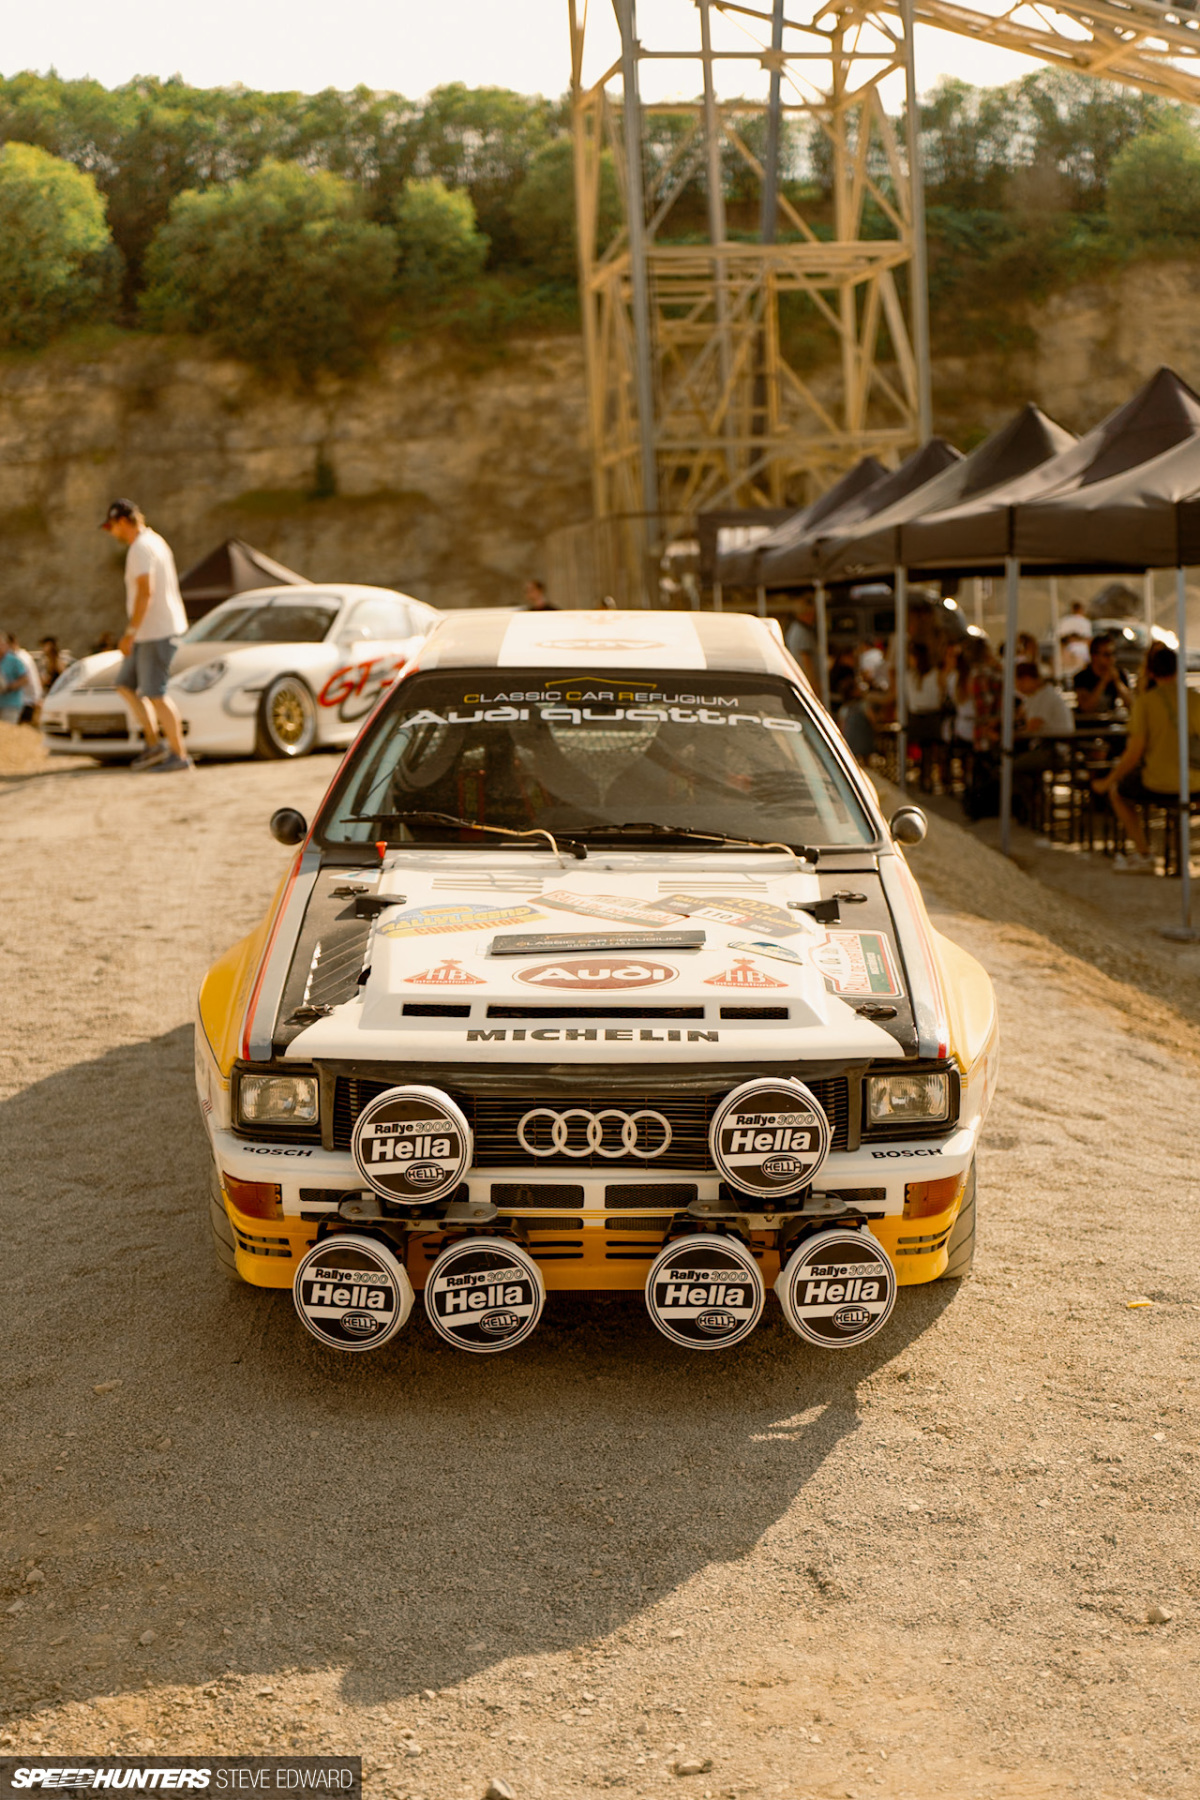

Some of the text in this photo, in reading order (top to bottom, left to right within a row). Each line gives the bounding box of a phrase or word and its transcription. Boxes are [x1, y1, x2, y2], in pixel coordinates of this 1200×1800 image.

[464, 691, 739, 707] CLASSIC CAR REFUGIUM
[400, 706, 802, 732] Audi quattro
[723, 898, 781, 914] 2022
[414, 918, 524, 935] COMPETITOR
[426, 968, 467, 980] HB
[528, 965, 665, 982] Audi
[725, 969, 766, 982] HB
[466, 1029, 719, 1042] MICHELIN
[374, 1120, 452, 1135] Rallye 3000
[736, 1114, 815, 1127] Rallye 3000
[730, 1129, 811, 1153] Hella
[243, 1146, 313, 1158] BOSCH
[371, 1136, 451, 1162] Hella
[871, 1148, 943, 1159] BOSCH
[407, 1167, 445, 1180] HELLA
[764, 1160, 802, 1173] HELLA
[315, 1268, 388, 1285] Rallye 3000
[669, 1270, 749, 1282] Rallye 3000
[810, 1264, 884, 1277] Rallye 3000
[446, 1269, 524, 1288] Rallye 3000
[310, 1283, 386, 1309] Hella
[664, 1284, 745, 1306] Hella
[803, 1278, 880, 1304] Hella
[445, 1284, 524, 1314] Hella
[342, 1316, 378, 1330] HELLA
[482, 1315, 519, 1328] HELLA
[700, 1315, 737, 1328] HELLA
[834, 1311, 871, 1323] HELLA
